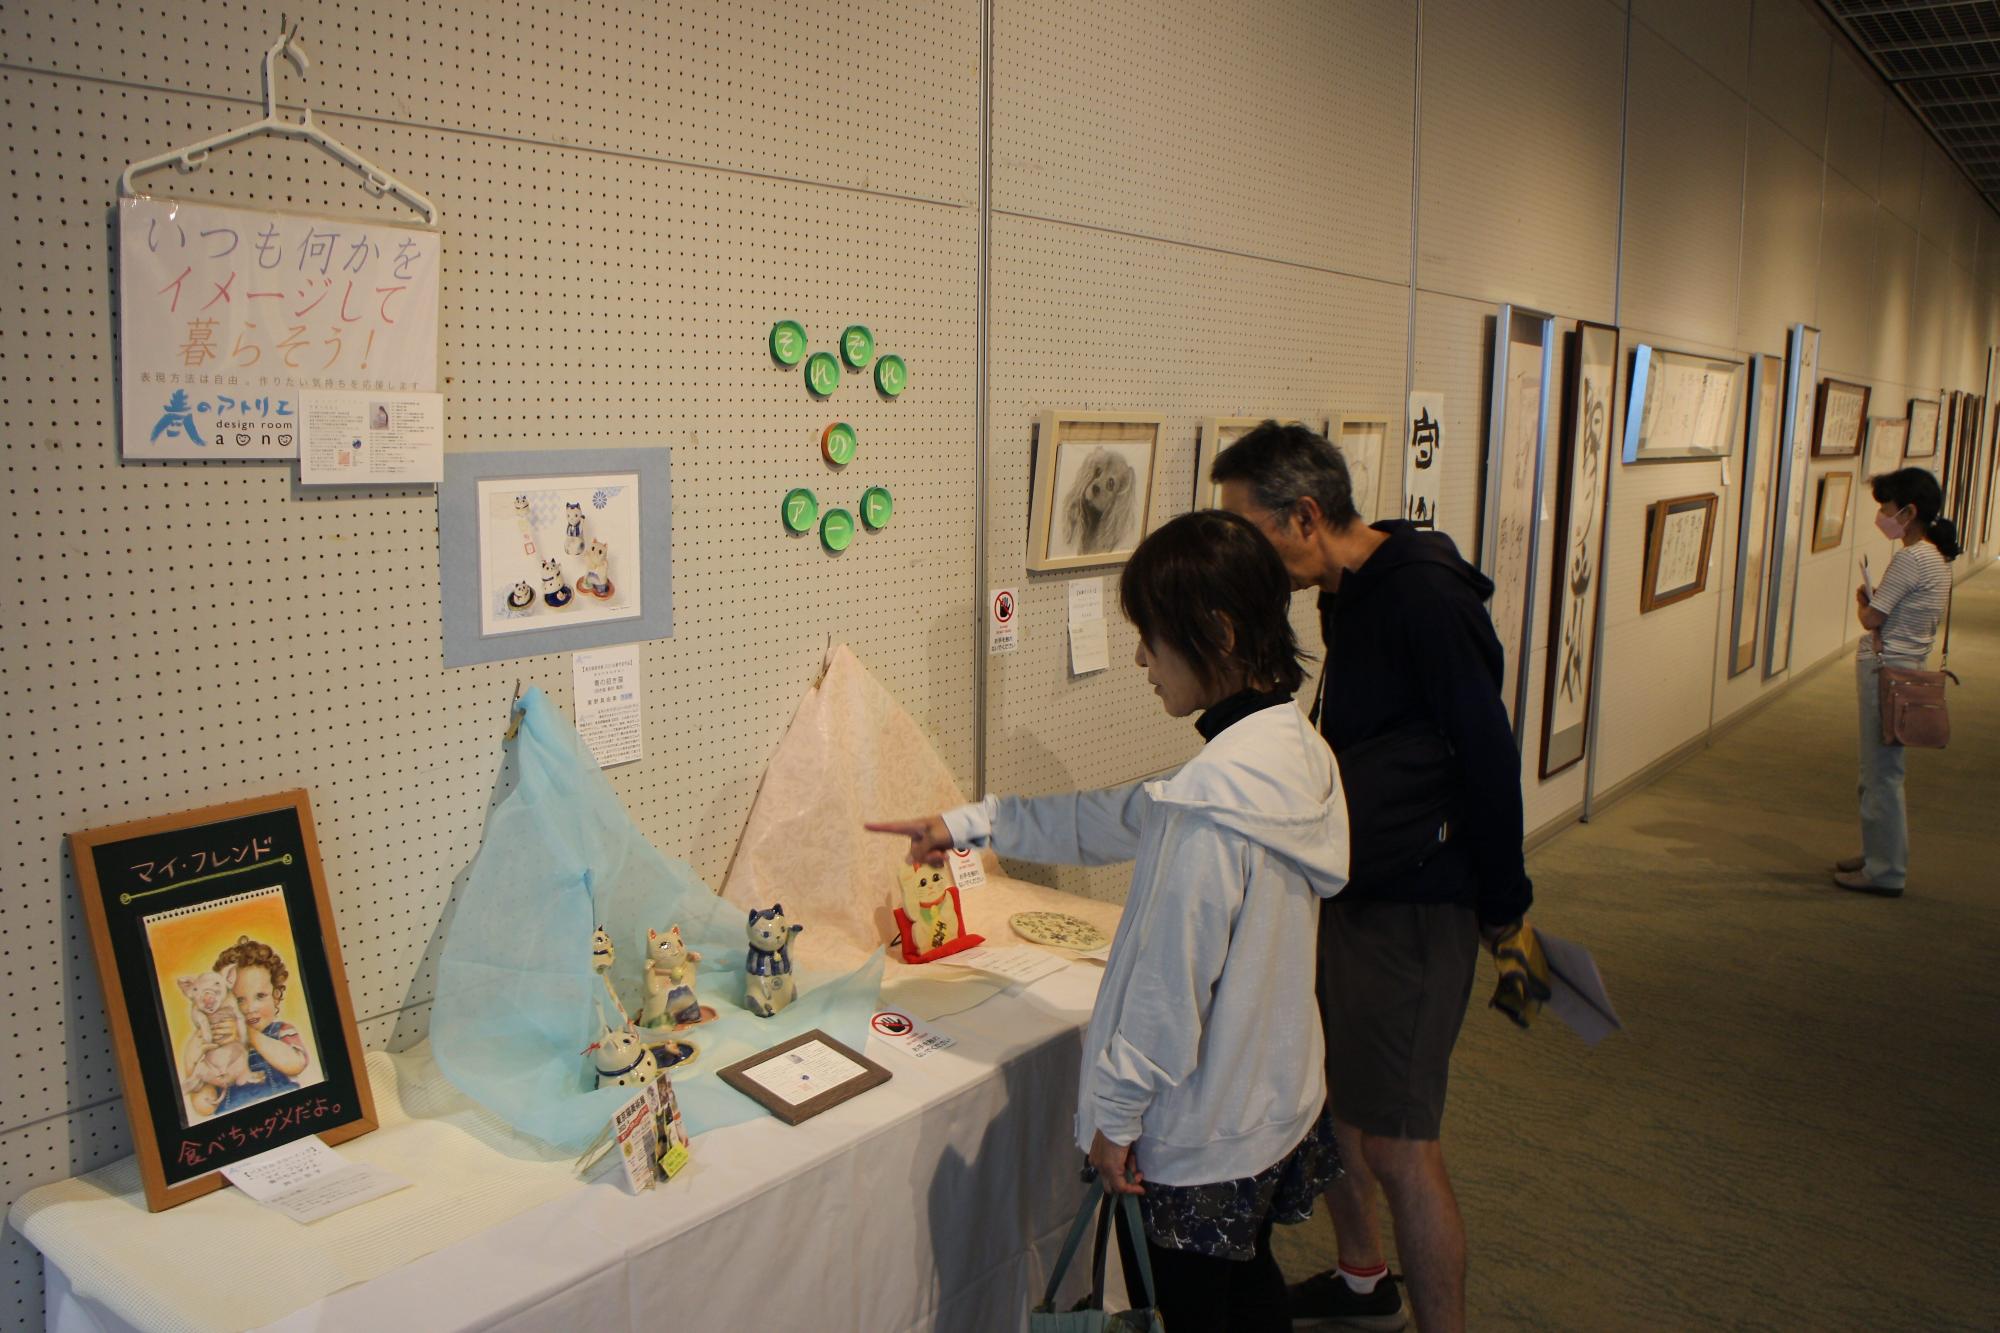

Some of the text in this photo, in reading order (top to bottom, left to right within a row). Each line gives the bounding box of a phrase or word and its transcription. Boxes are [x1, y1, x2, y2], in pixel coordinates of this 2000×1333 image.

[148, 219, 421, 280] いつも何かを
[158, 266, 406, 325] イメージして
[216, 420, 293, 431] design room
[129, 837, 272, 882] マイ・フレンド
[178, 1098, 342, 1167] 食べちゃダメだよ。
